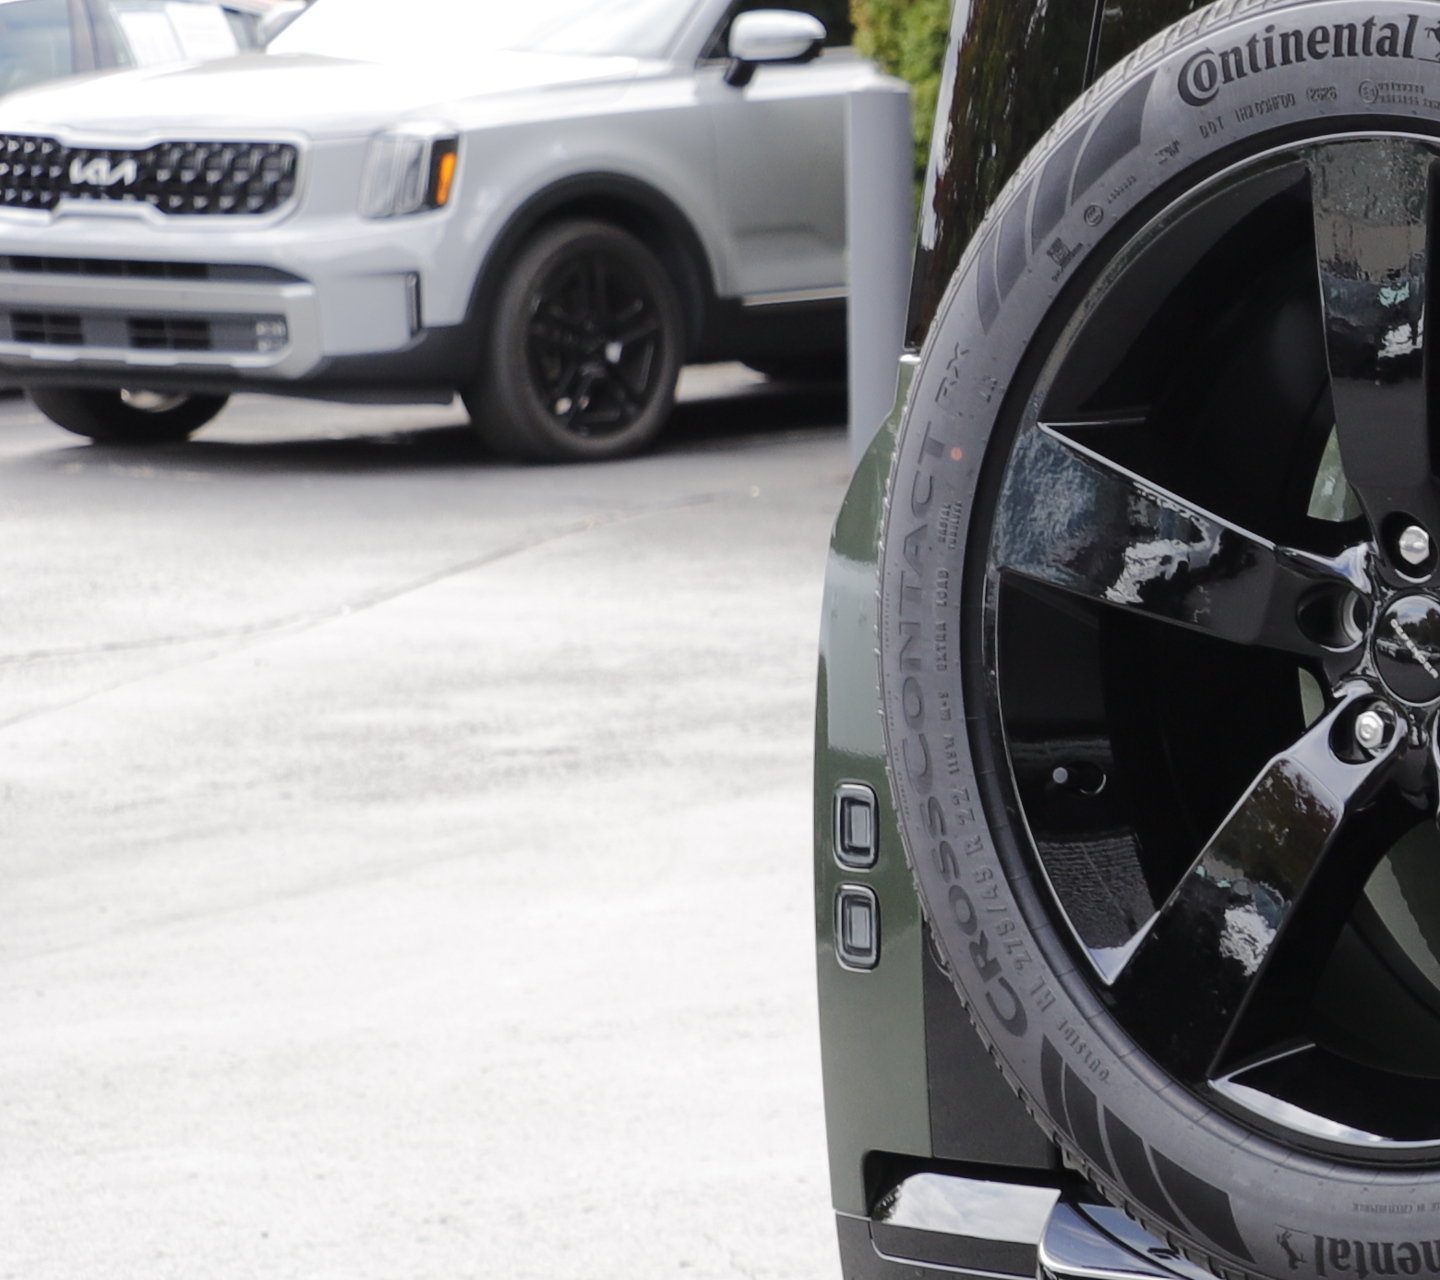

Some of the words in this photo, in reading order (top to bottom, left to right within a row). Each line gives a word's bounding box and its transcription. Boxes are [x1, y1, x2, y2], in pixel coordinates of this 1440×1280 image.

[1177, 14, 1418, 107] Continental
[934, 566, 951, 607] LOAD
[949, 785, 976, 828] 22
[963, 834, 985, 858] R
[972, 866, 1034, 974] 275/45
